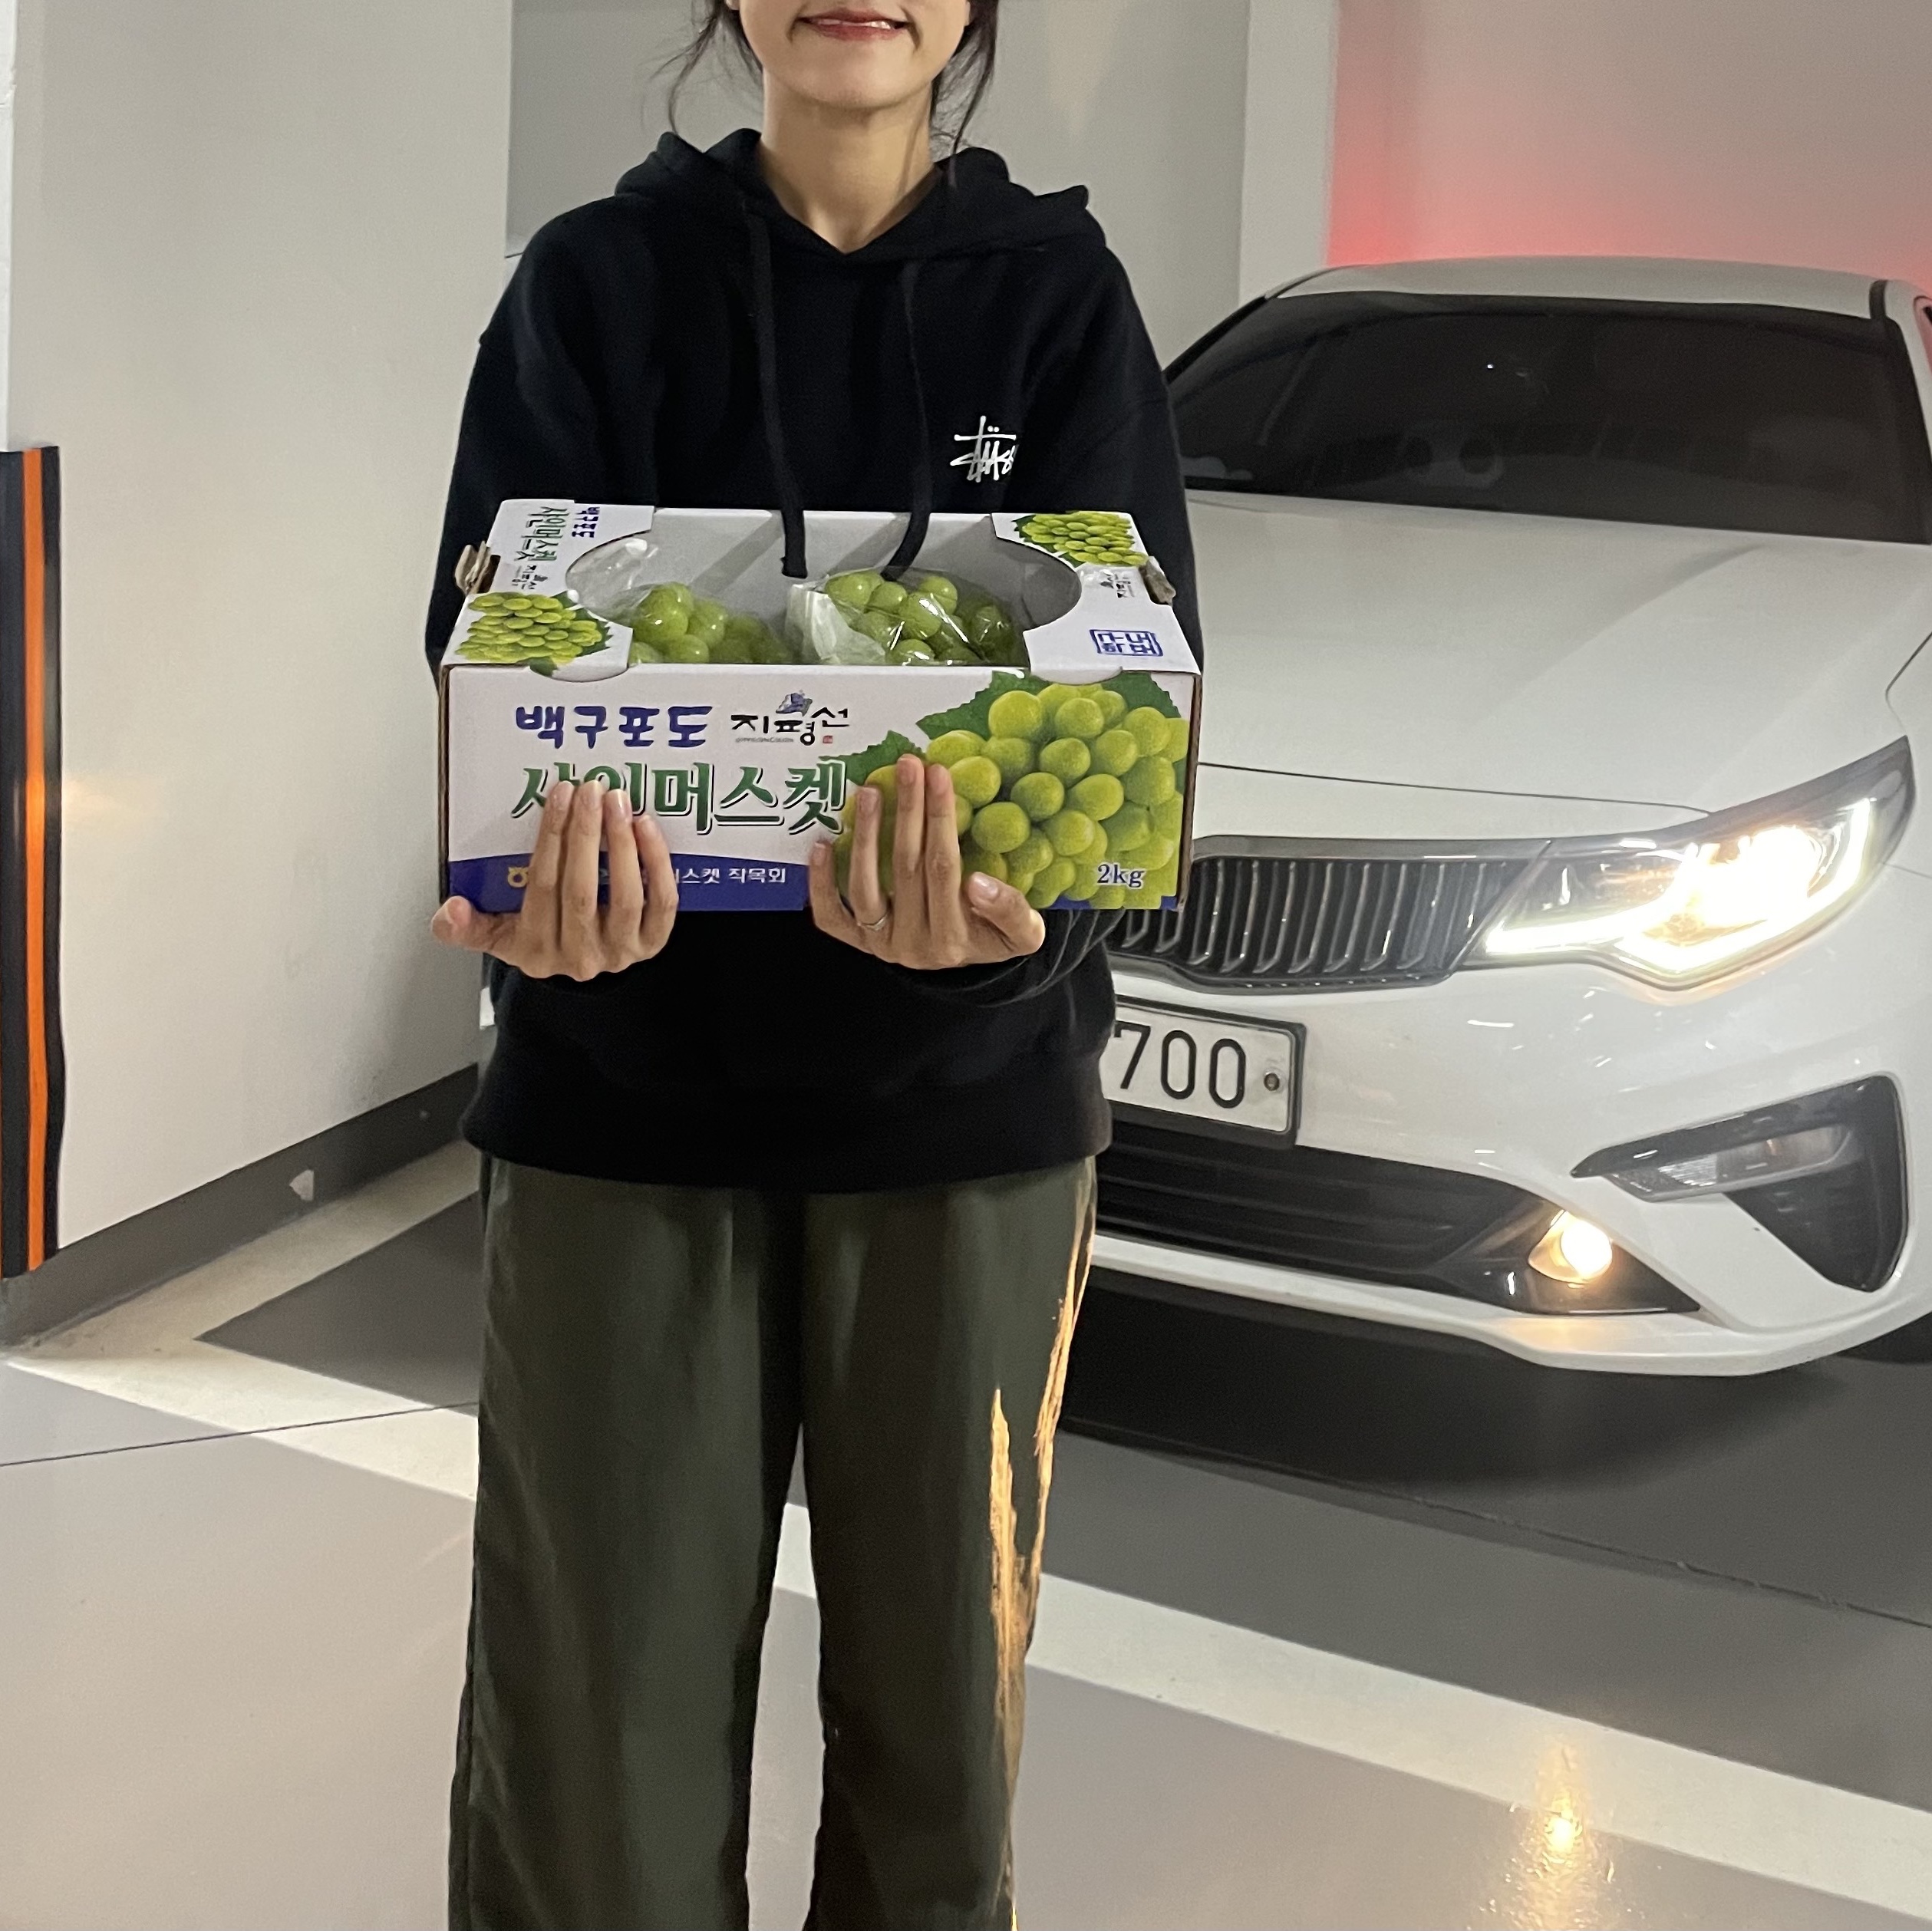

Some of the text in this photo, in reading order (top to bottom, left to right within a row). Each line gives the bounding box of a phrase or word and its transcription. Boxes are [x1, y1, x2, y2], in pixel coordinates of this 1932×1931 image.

[516, 705, 850, 750] 백구포도 지평선
[728, 867, 786, 884] 작목회
[1097, 864, 1145, 888] 2kg
